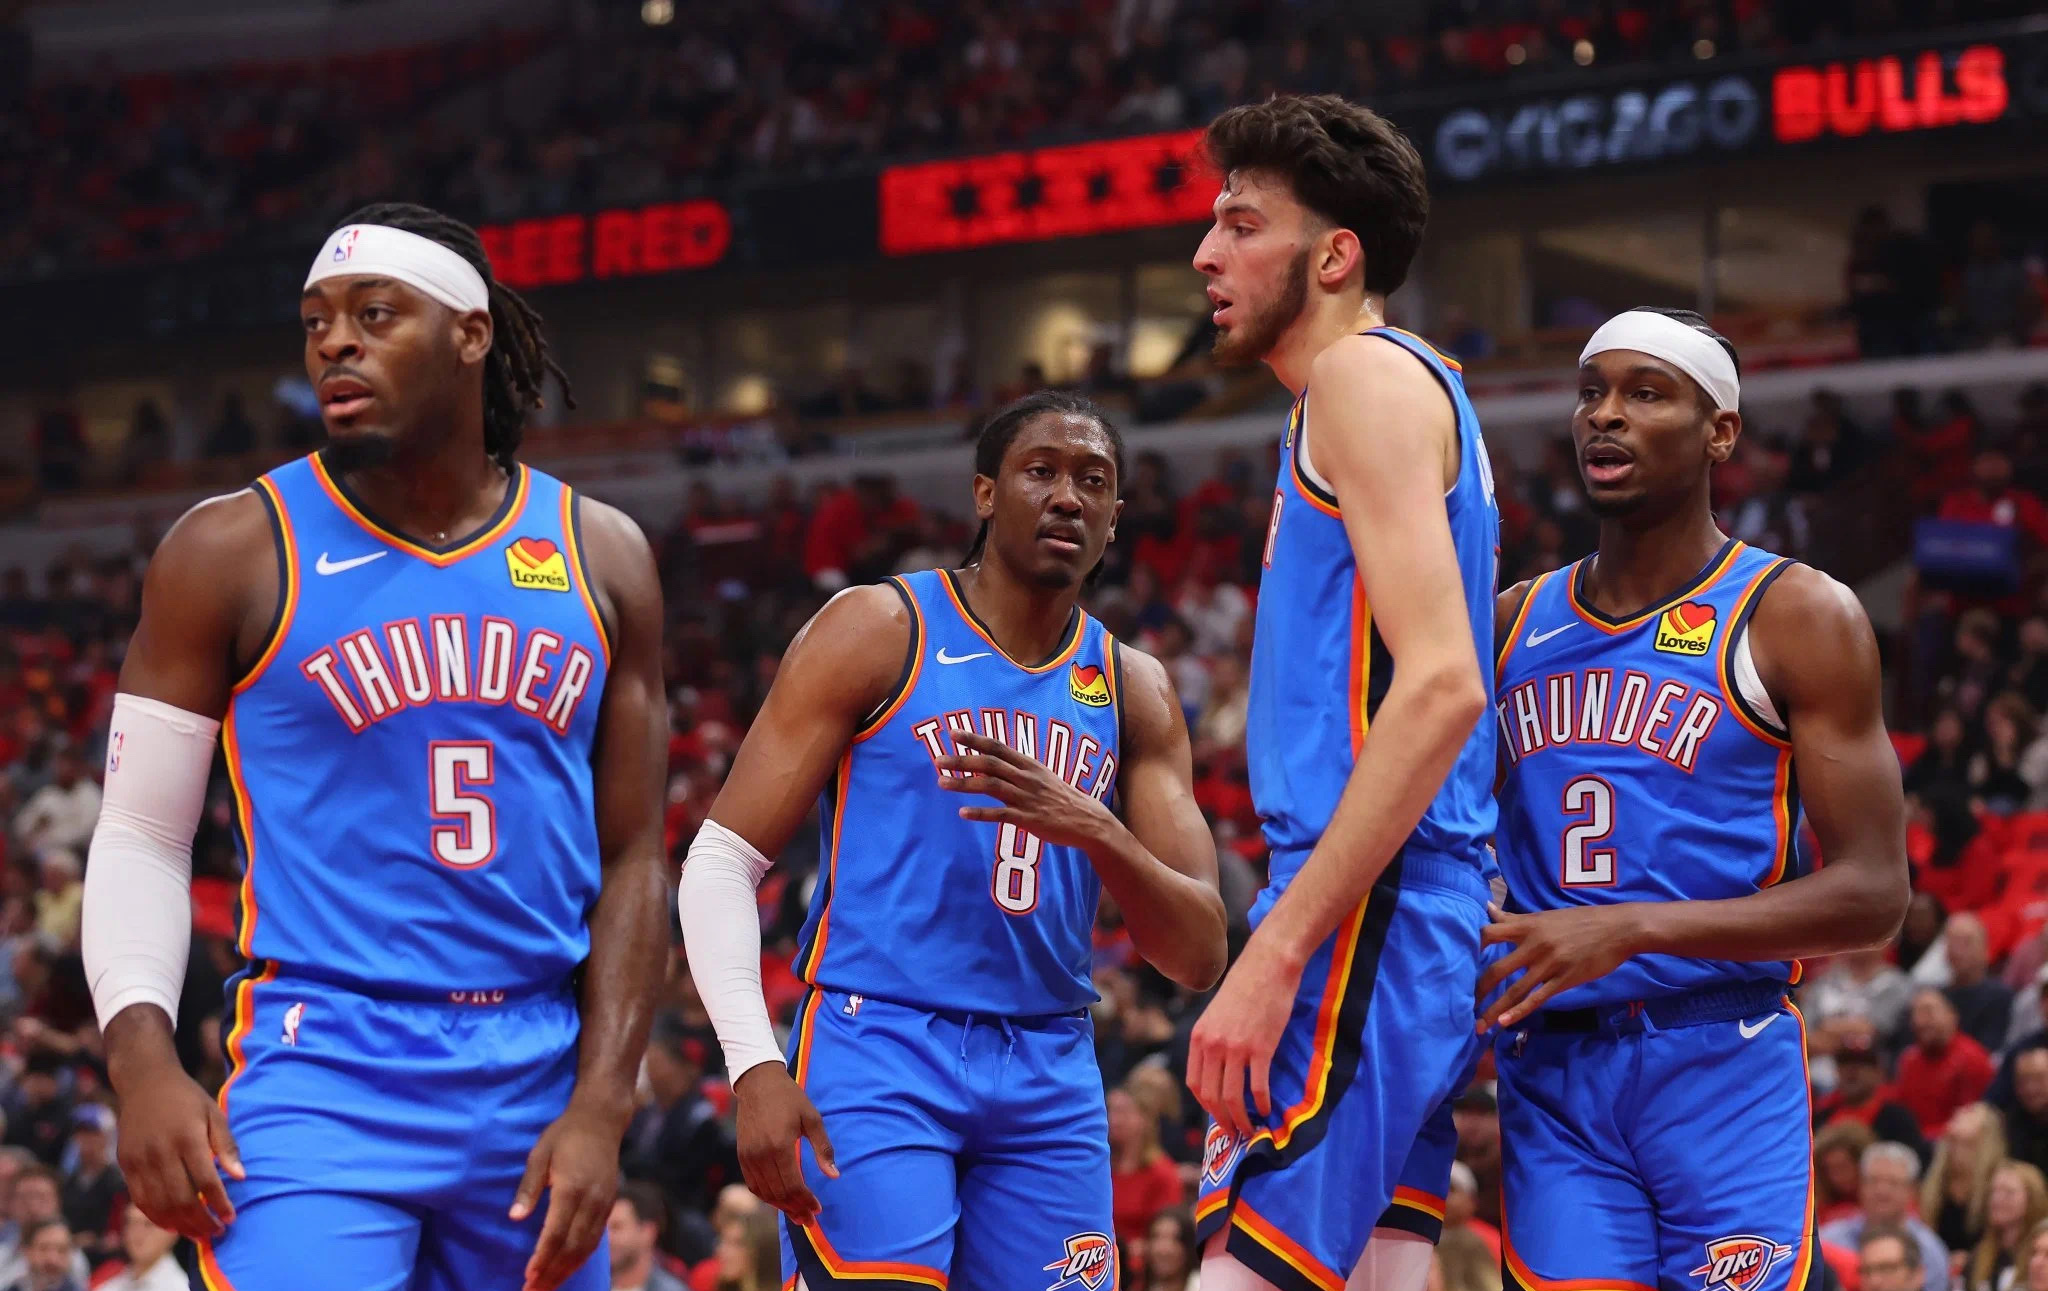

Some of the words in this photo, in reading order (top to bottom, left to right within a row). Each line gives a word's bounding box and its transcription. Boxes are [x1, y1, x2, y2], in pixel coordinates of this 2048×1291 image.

[1771, 43, 2008, 144] BULLS
[594, 198, 730, 279] RED
[299, 613, 595, 735] THUNDER
[1496, 667, 1722, 775] THUNDER
[428, 740, 497, 870] 5
[1560, 773, 1617, 889] 2
[990, 819, 1044, 917] 8
[1064, 1244, 1107, 1278] OKC
[1707, 1246, 1761, 1285] OKC
